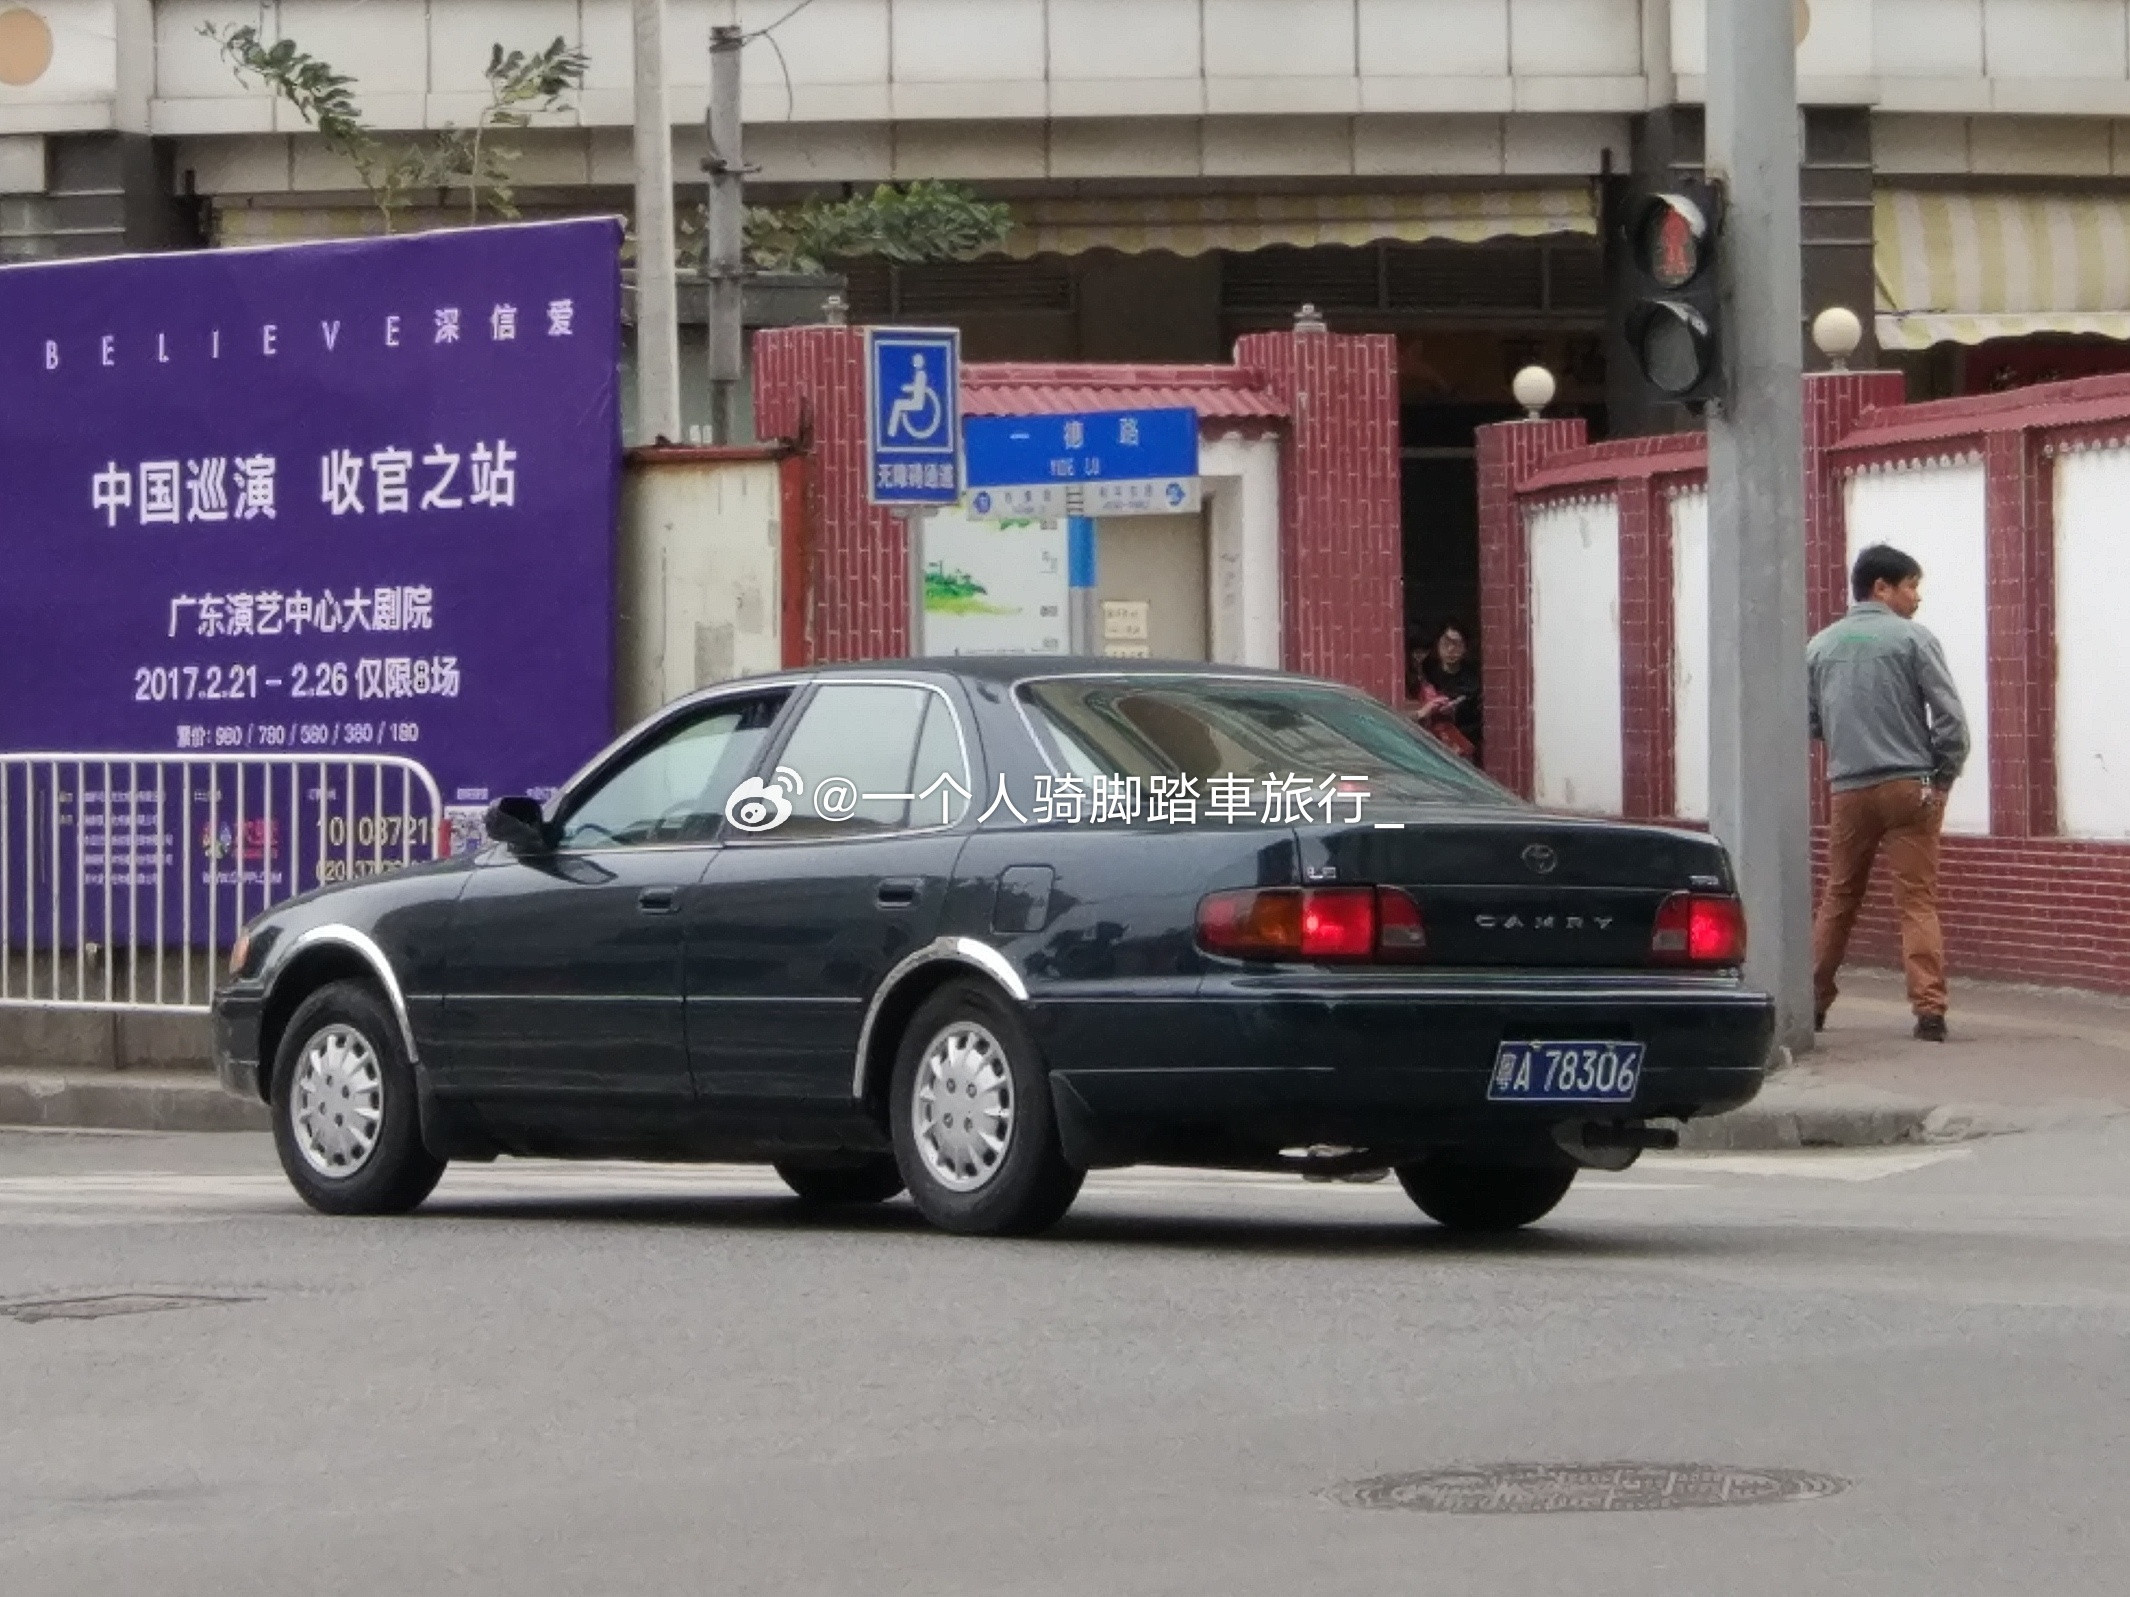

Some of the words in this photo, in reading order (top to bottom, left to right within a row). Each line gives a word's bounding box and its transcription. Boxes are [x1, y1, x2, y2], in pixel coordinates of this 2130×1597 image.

[434, 299, 574, 344] 深信爱
[92, 453, 277, 527] 中国巡演
[320, 440, 517, 516] 收官之站
[168, 585, 433, 638] 广东演艺中心大剧院
[135, 665, 257, 700] 2017.2.21
[291, 662, 348, 697] 2.26
[355, 656, 461, 700] 仅限8场
[1475, 914, 1613, 930] CAMRY
[1543, 1049, 1637, 1092] 78306
